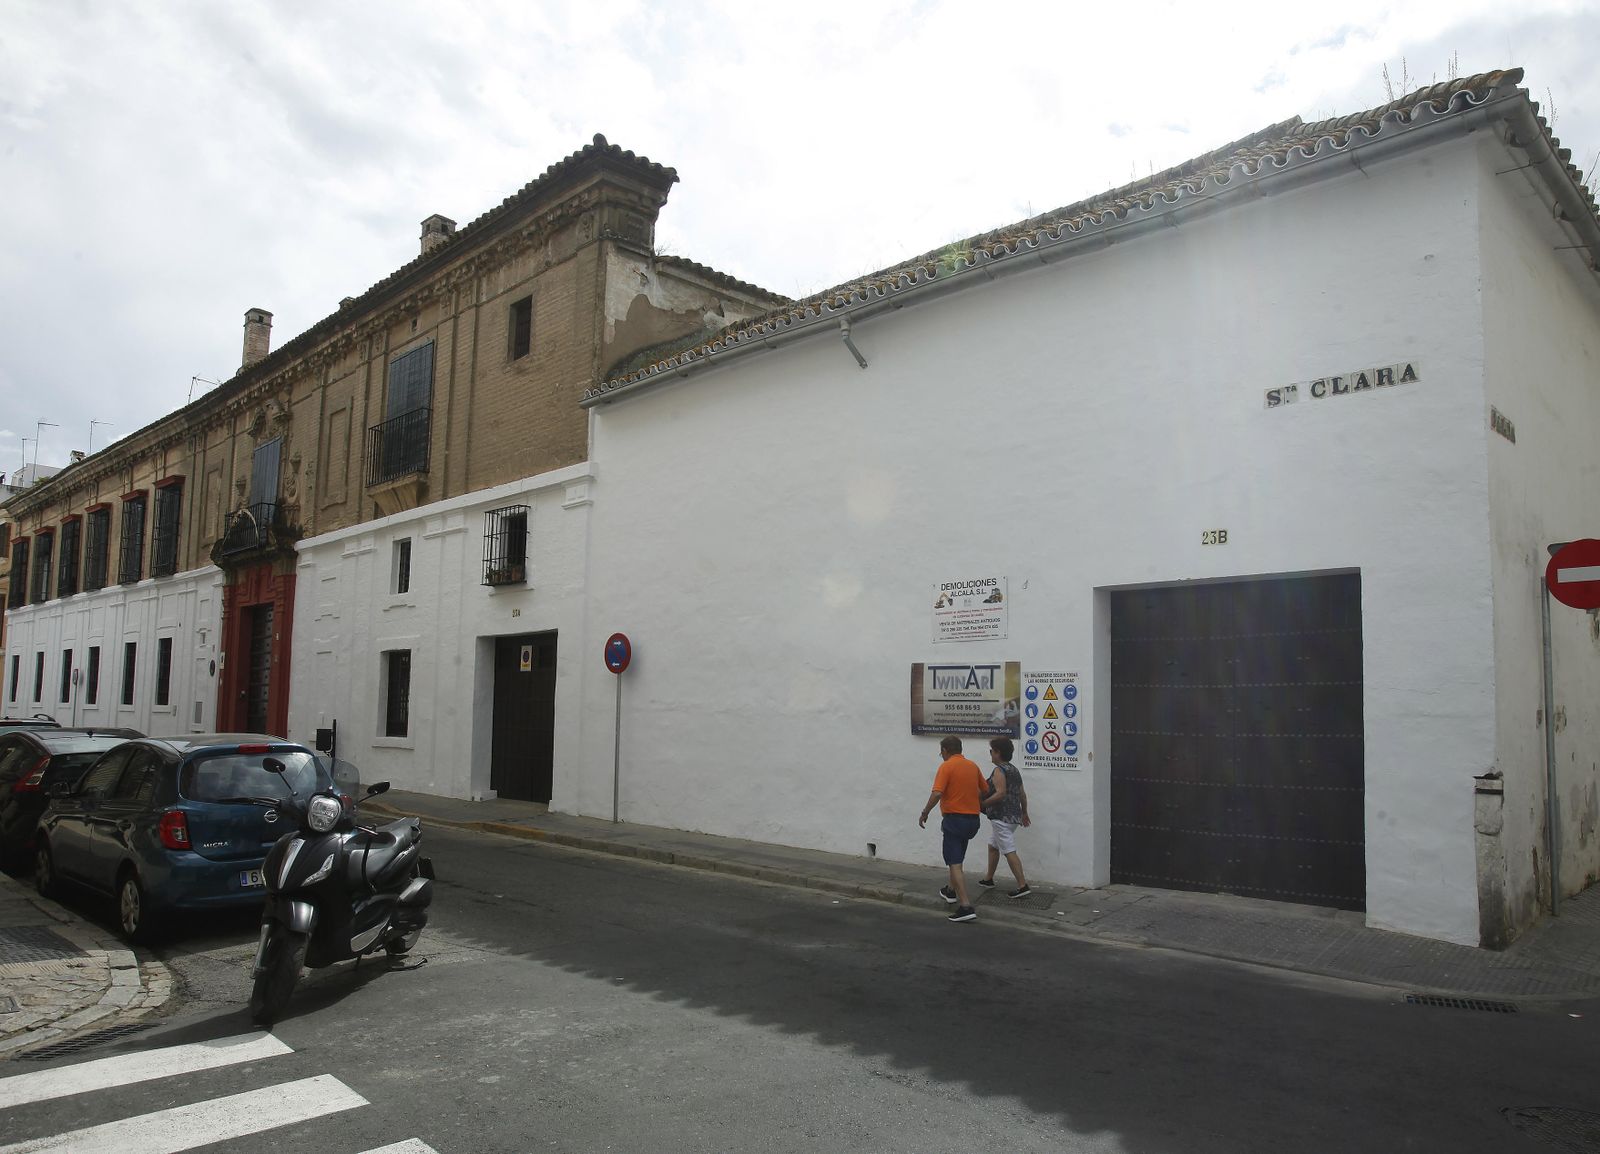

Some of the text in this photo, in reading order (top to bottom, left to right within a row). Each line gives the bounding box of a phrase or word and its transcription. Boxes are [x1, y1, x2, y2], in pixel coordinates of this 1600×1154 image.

[1311, 363, 1418, 398] CLARA
[1202, 530, 1227, 544] 23B
[941, 578, 998, 591] DEMOLICIONES
[945, 704, 955, 712] 955
[956, 704, 963, 712] 68
